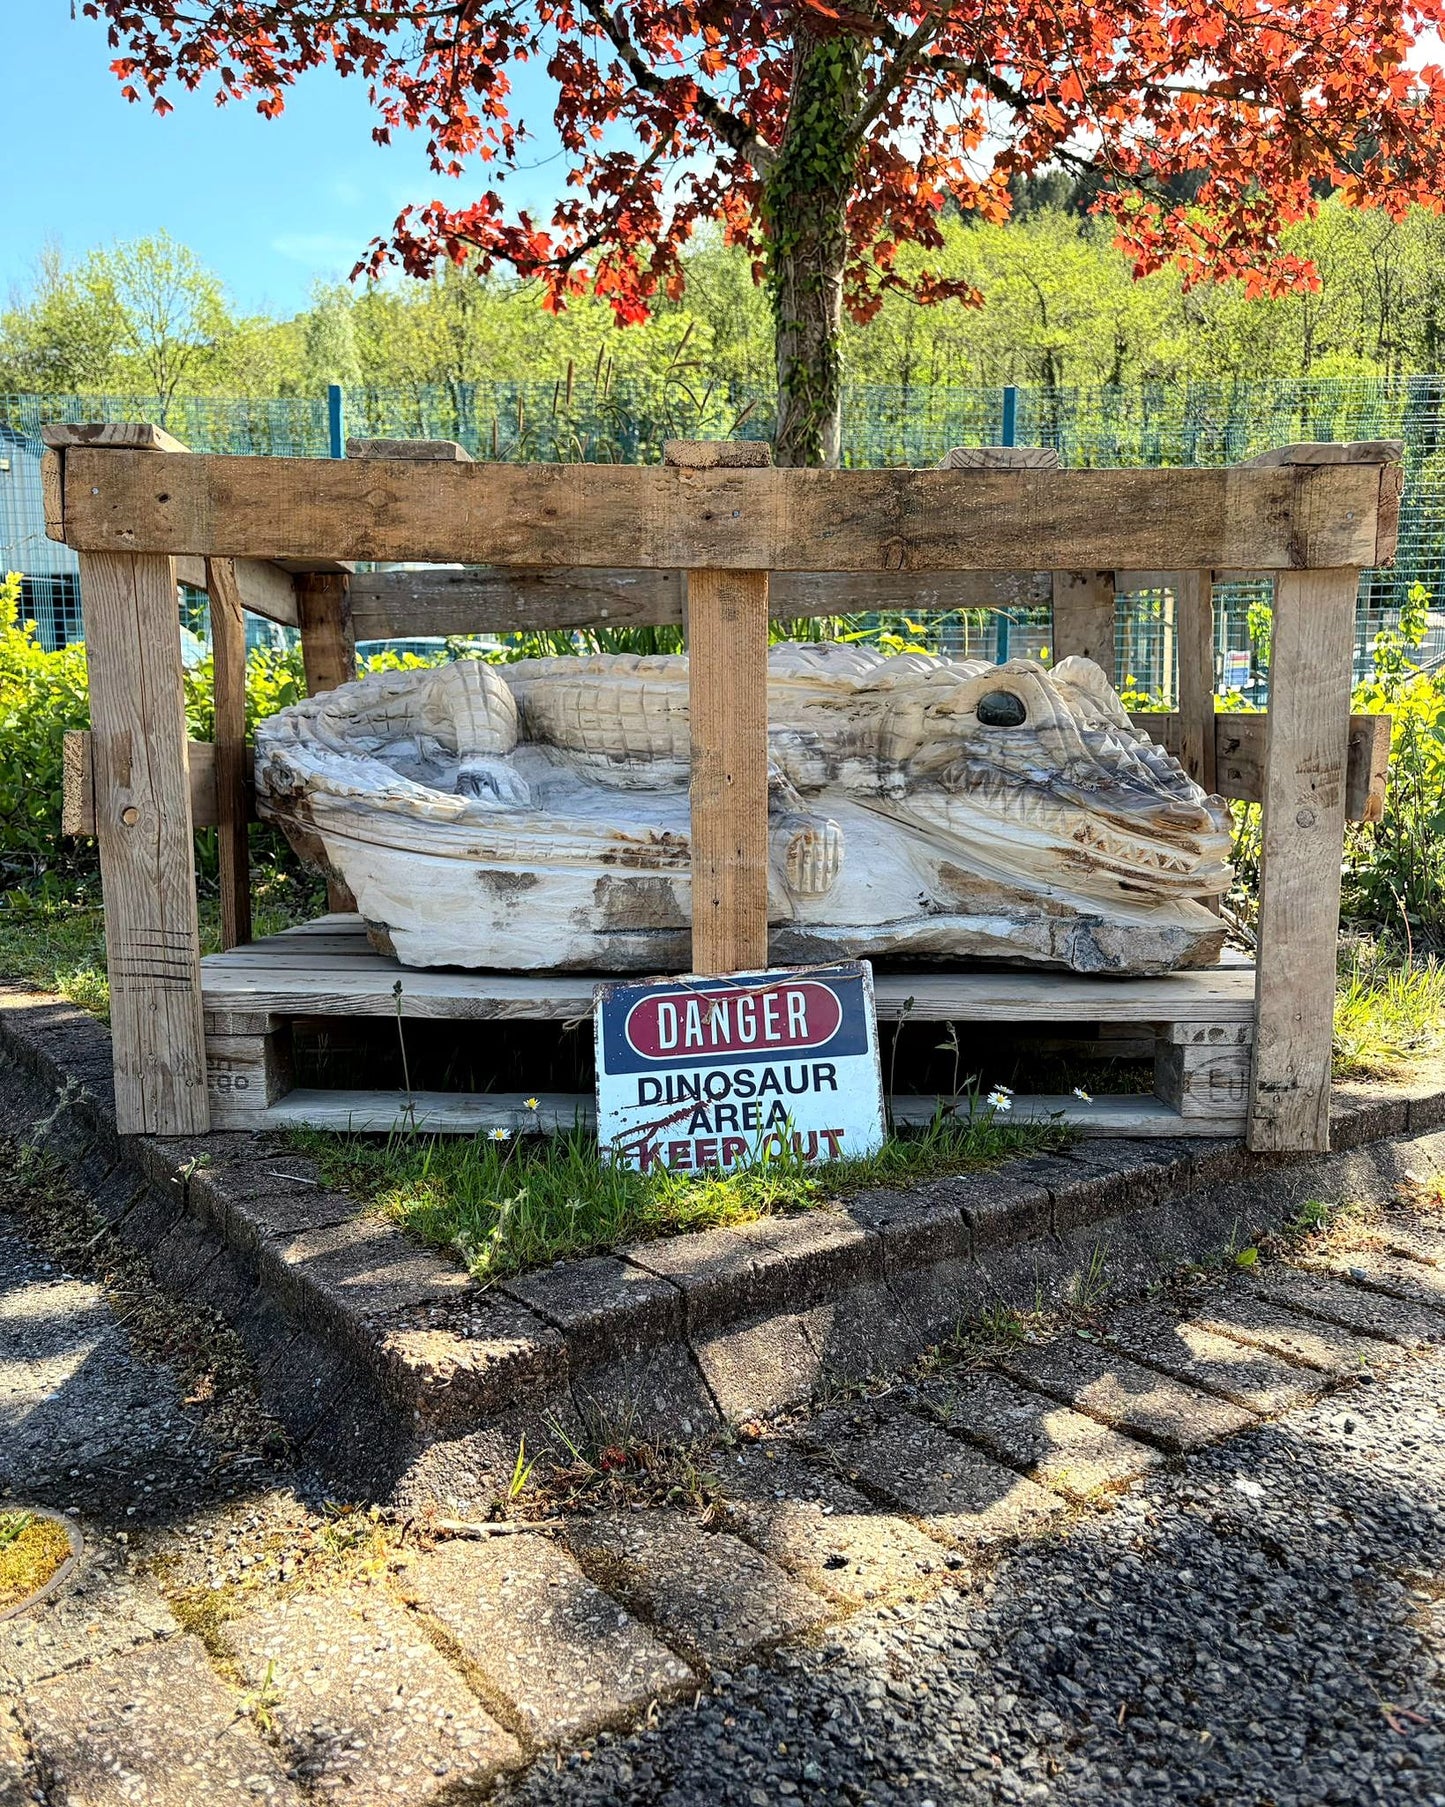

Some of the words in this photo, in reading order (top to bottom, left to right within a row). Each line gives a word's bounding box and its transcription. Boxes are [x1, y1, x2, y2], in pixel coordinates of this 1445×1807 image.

[657, 990, 809, 1050] DANGER
[637, 1062, 838, 1106] DINOSAUR
[687, 1099, 792, 1135] AREA
[639, 1136, 747, 1172] KEEP
[762, 1128, 844, 1162] OUT
